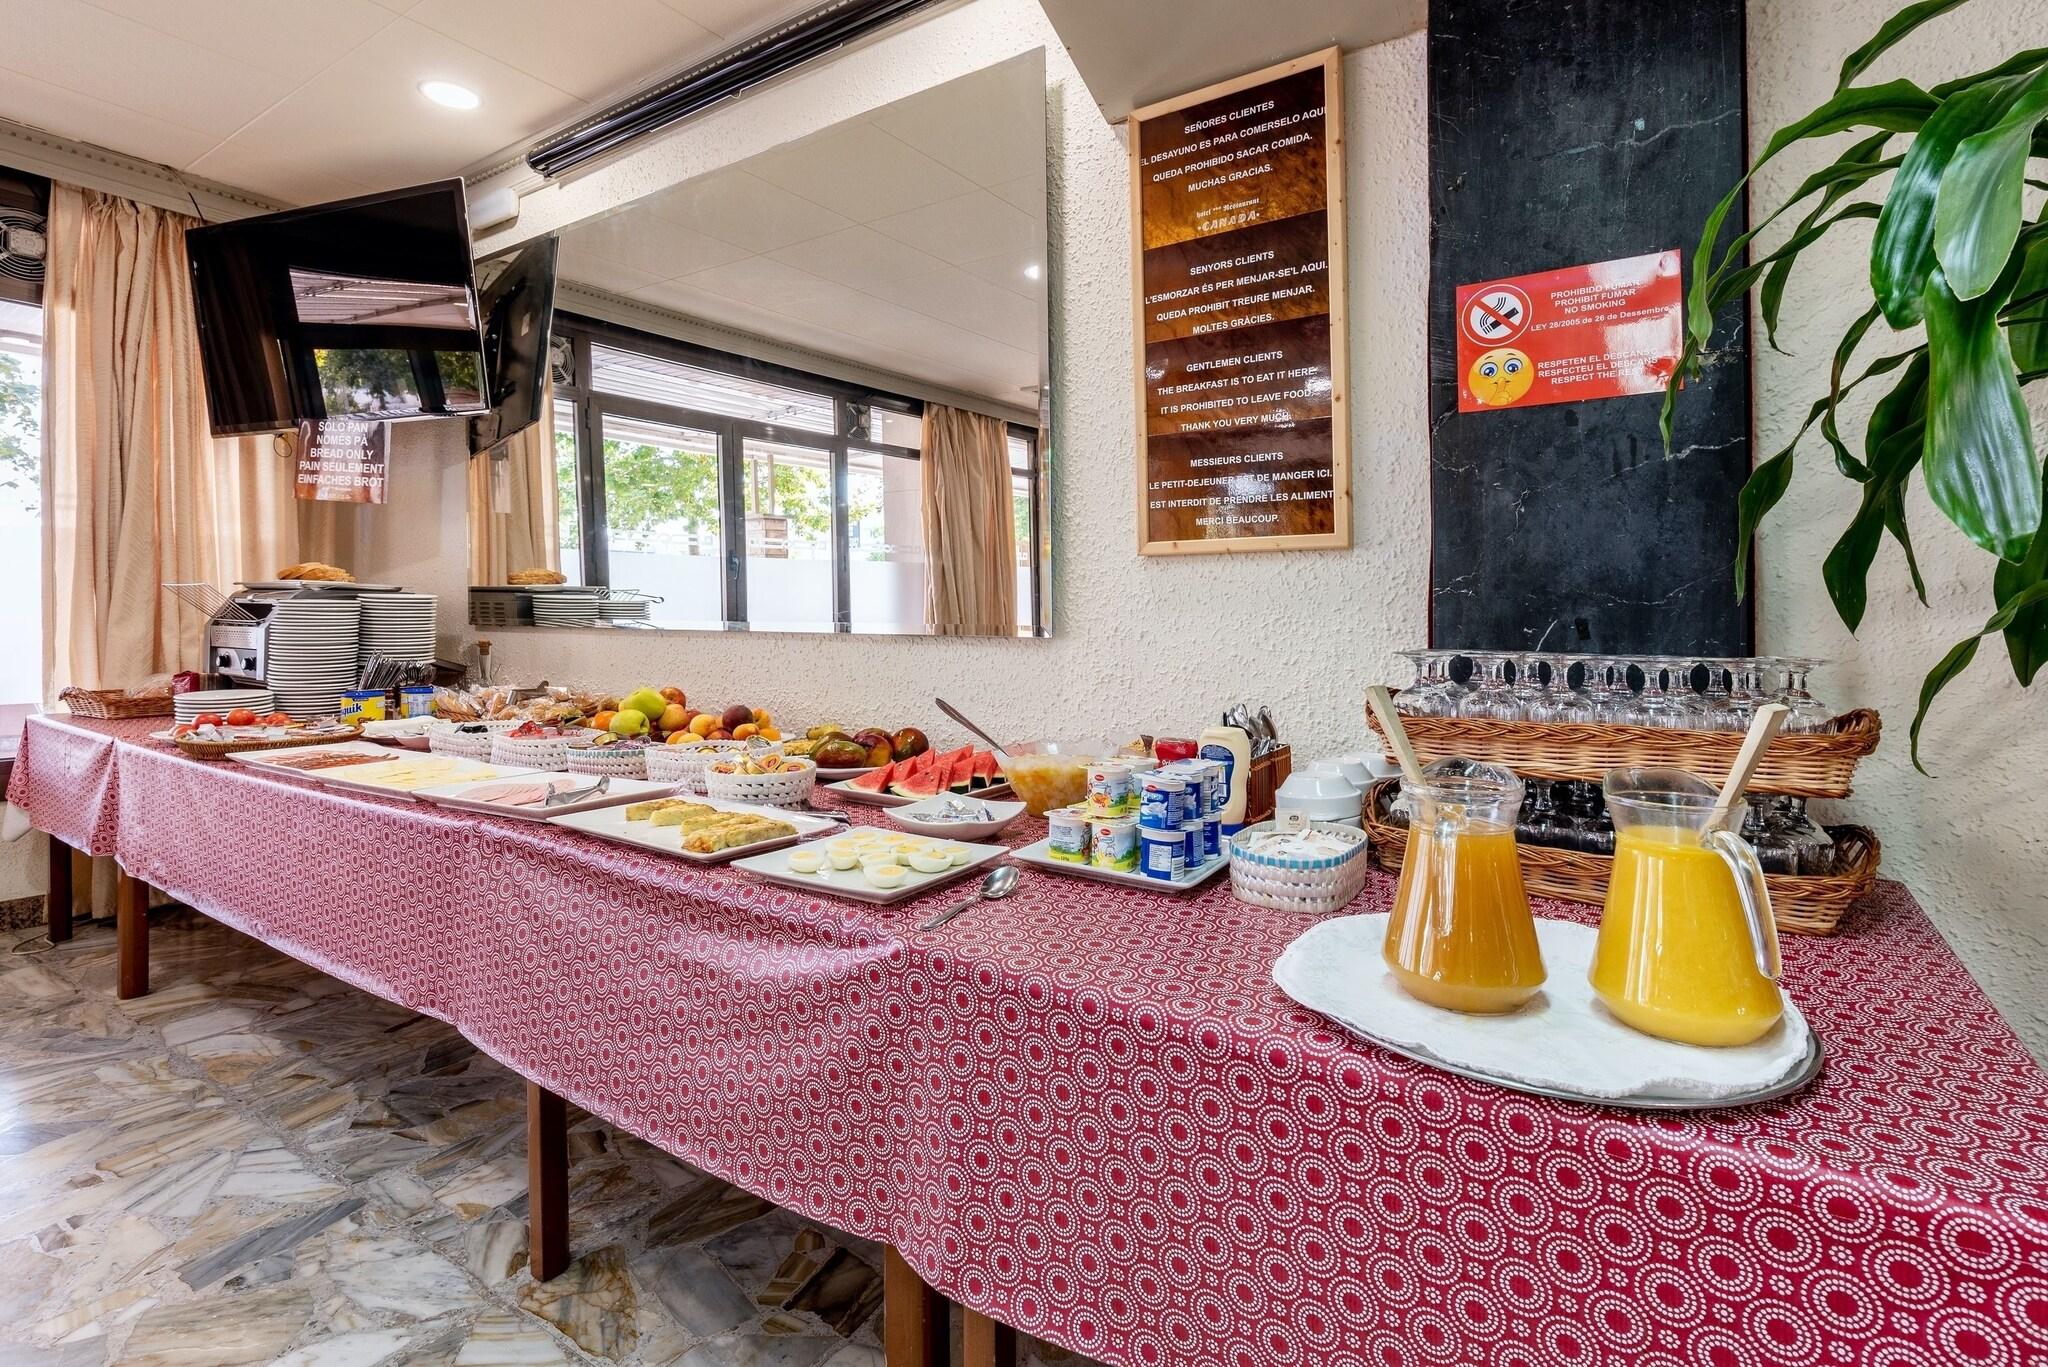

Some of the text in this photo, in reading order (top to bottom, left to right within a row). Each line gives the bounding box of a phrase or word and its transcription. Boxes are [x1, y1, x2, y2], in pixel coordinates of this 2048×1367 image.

[1184, 100, 1275, 134] SEÑORES CLIENTES
[1150, 143, 1198, 164] DESAYUNO
[1199, 139, 1211, 149] ES
[1213, 131, 1238, 146] PARA
[1239, 113, 1300, 138] COMERSELO
[1152, 132, 1313, 182] QUEDA PROHIBIDO SACAR COMIDA.
[1188, 163, 1273, 193] MUCHAS GRACIAS.
[1190, 250, 1275, 276] SENYORS CLIENTS
[1145, 261, 1328, 305] L'ESMORZAR ÉS PER MENJAR-SE'L AQUI.
[1551, 280, 1641, 300] PROHIBIDO FUMAR
[1156, 284, 1315, 322] QUEDA PROHIBIT TREURE MENJAR.
[1554, 288, 1637, 307] PROHIBIT FUMAR
[1564, 298, 1626, 314] NO SMOKING
[1192, 313, 1275, 335] MOLTES GRÀCIES.
[1531, 323, 1547, 332] LEY
[1548, 316, 1581, 329] 28/2005
[1582, 316, 1593, 324] de
[1594, 314, 1605, 322] 26
[1607, 312, 1618, 321] de
[1186, 350, 1283, 373] GENTLEMEN CLIENTS
[1537, 349, 1658, 369] RESPETEN EL DESCANSO
[1538, 357, 1658, 378] RESPECTEU EL DESCANS
[1157, 386, 1175, 396] THE
[1176, 379, 1228, 394] BREAKFAST
[1230, 377, 1240, 387] IS
[1241, 375, 1255, 385] TO
[1256, 372, 1275, 382] EAT
[1276, 371, 1286, 380] IT
[1551, 367, 1645, 385] RESPECT THE REST
[1160, 405, 1169, 415] IT
[1170, 404, 1179, 414] IS
[1180, 397, 1234, 413] PROHIBITED
[1236, 396, 1249, 406] TO
[1250, 392, 1281, 404] LEAVE
[347, 422, 368, 433] PAN
[1181, 420, 1211, 432] THANK
[1212, 418, 1232, 428] YOU
[1233, 415, 1259, 427] VERY
[310, 447, 374, 460] BREAD ONLY
[1190, 451, 1284, 468] MESSIEURS CLIENTS
[299, 461, 385, 474] PAIN SEULEMENT
[297, 473, 384, 487] EINFACHES BROT
[1149, 481, 1160, 490] LE
[1161, 476, 1234, 489] PETIT-DEJEUNER
[1257, 472, 1270, 482] DE
[1272, 469, 1314, 482] MANGER
[1316, 468, 1333, 479] ICI.
[1150, 500, 1166, 509] EST
[1167, 497, 1208, 509] INTERDIT
[1209, 496, 1222, 506] DE
[1223, 494, 1268, 505] PRENDRE
[1269, 492, 1289, 502] LES
[1195, 513, 1279, 526] MERCI BEAUCOUP.
